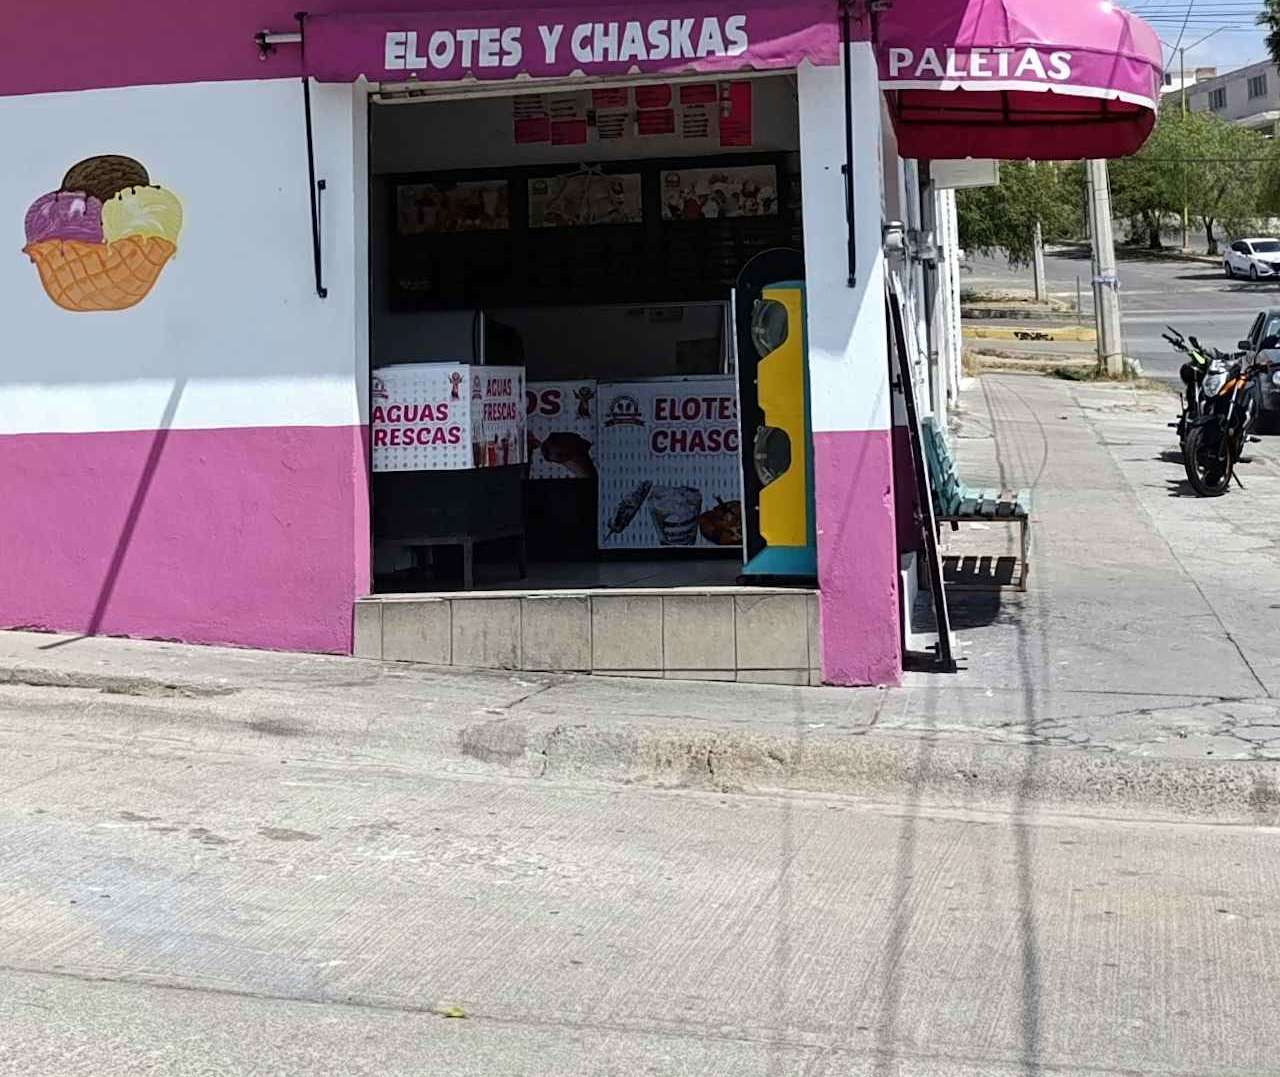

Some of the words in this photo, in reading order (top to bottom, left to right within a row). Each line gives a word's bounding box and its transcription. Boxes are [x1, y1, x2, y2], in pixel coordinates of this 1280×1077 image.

[384, 27, 522, 70] ELOTES
[538, 25, 563, 63] Y
[571, 15, 748, 62] CHASKAS
[889, 47, 1072, 81] PALETAS
[486, 379, 512, 396] AGUAS
[372, 403, 449, 423] AGUAS
[483, 402, 516, 421] FRESCAS
[654, 397, 737, 420] ELOTE
[374, 426, 461, 446] RESCAS
[651, 429, 738, 453] CHASC
